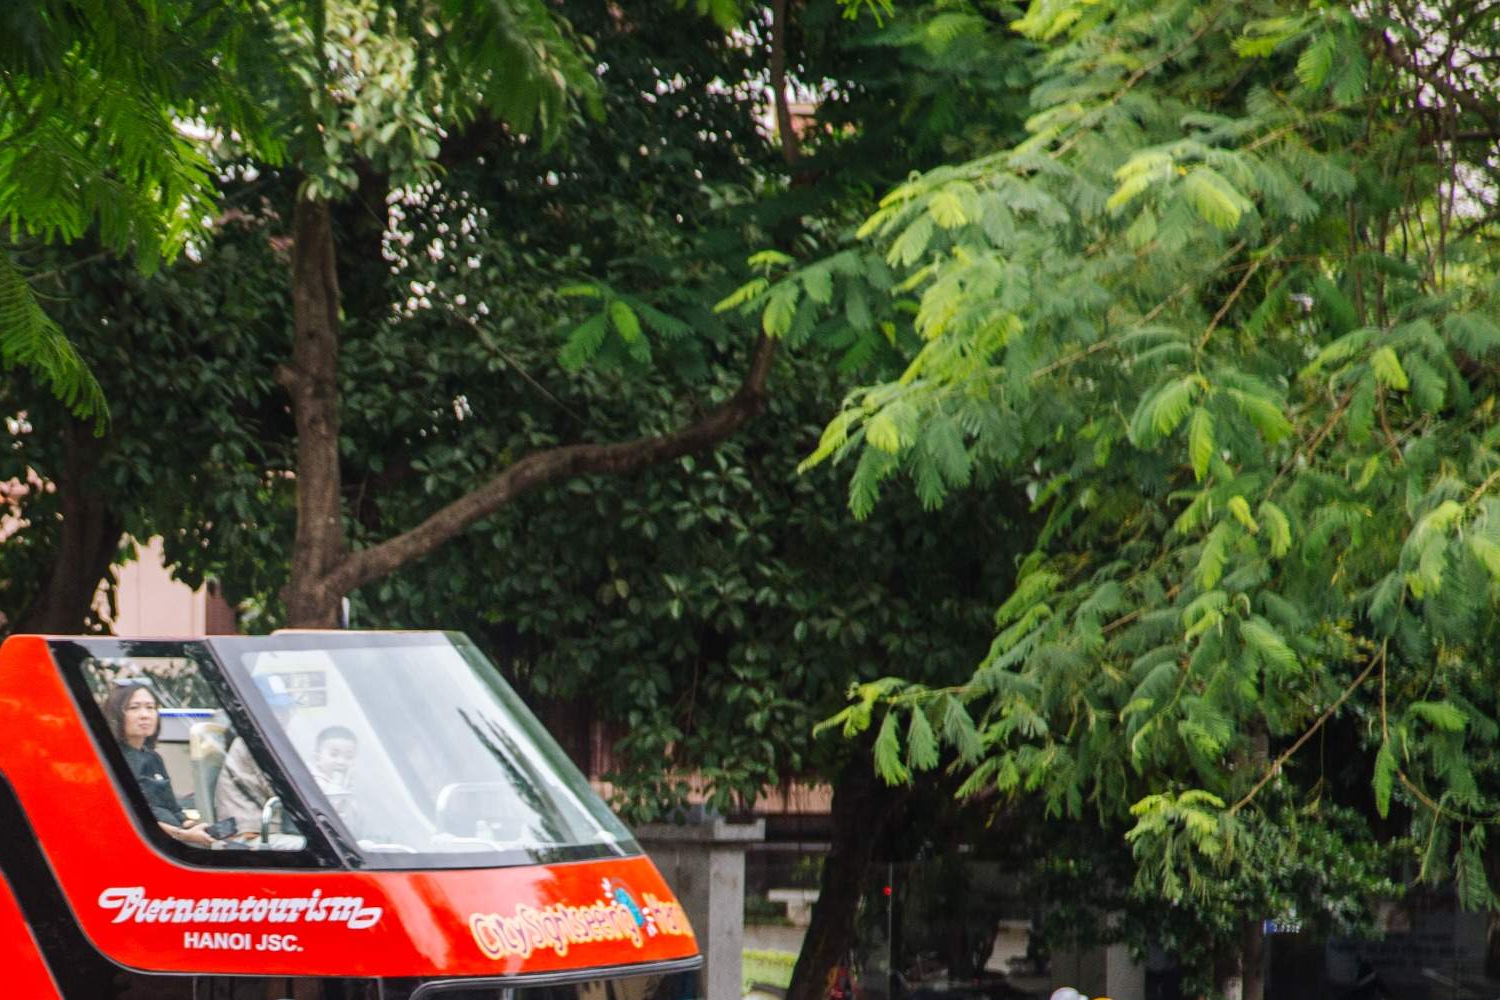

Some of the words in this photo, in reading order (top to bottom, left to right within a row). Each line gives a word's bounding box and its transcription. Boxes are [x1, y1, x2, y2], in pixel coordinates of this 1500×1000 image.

[98, 886, 383, 929] Vietnamtourism
[184, 932, 252, 951] HANOI
[256, 934, 304, 952] JSC.
